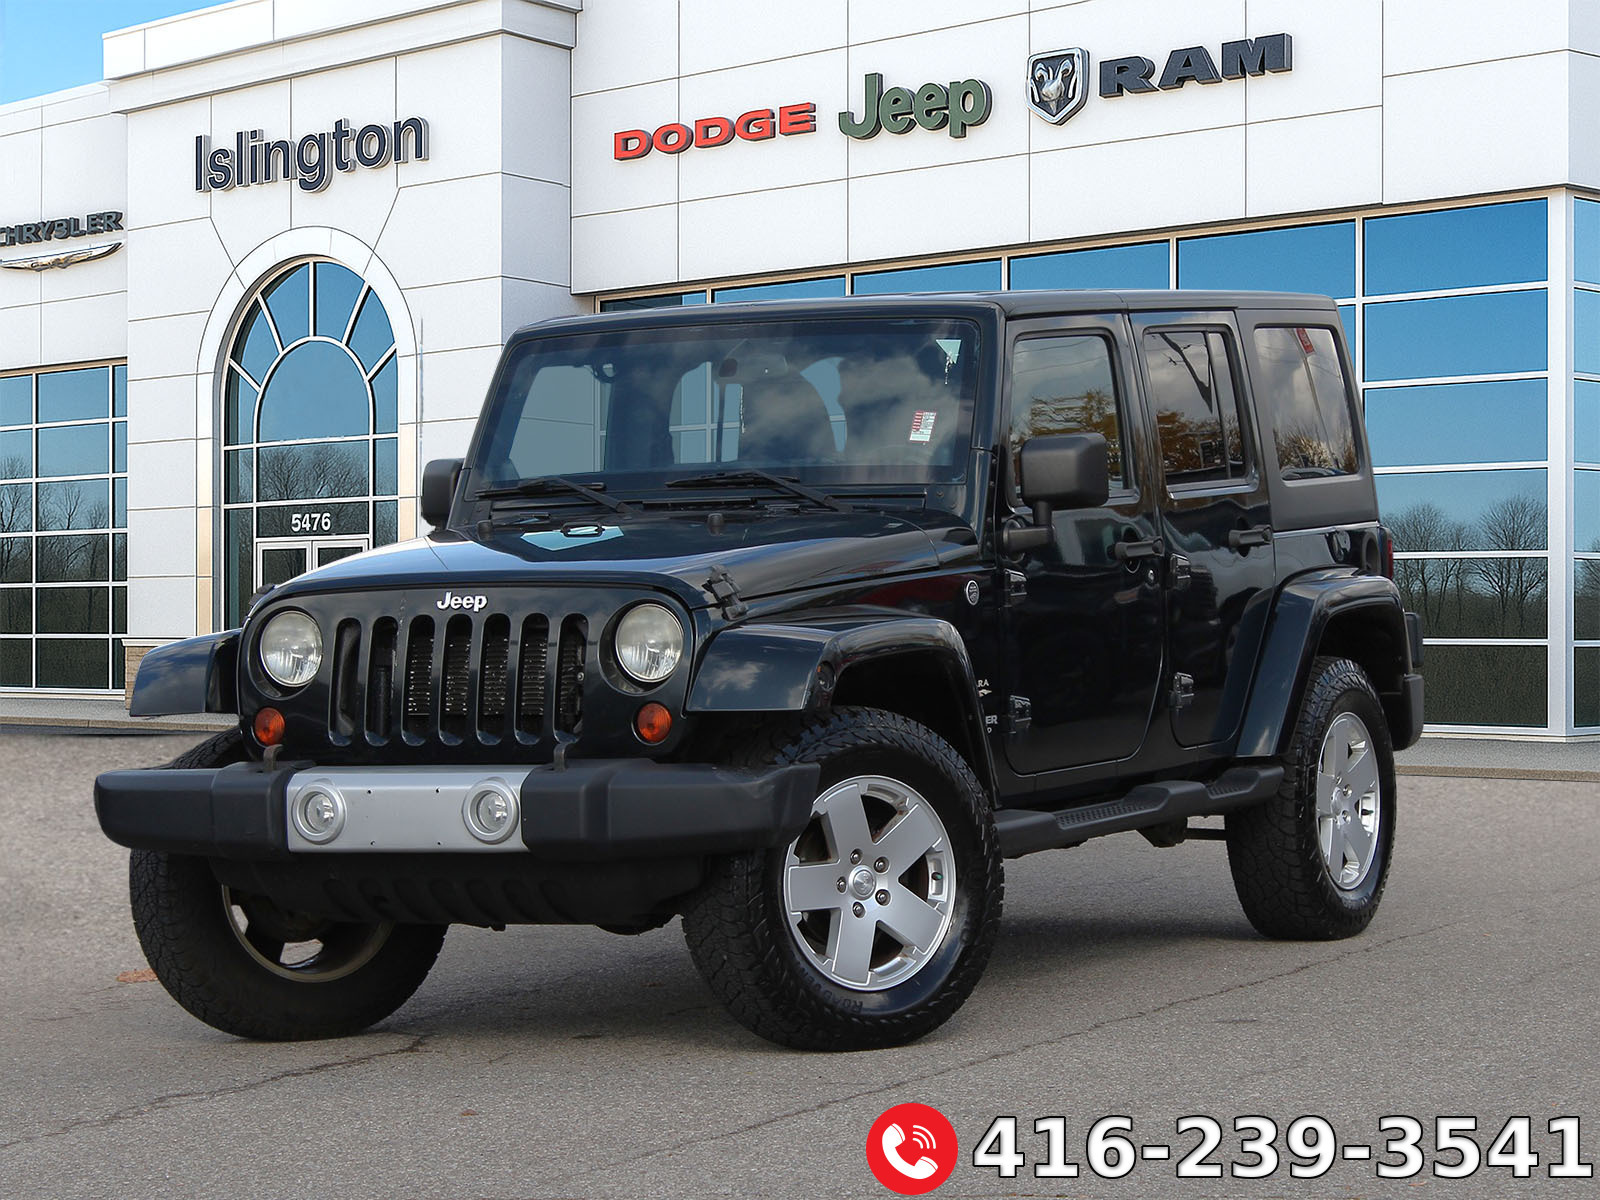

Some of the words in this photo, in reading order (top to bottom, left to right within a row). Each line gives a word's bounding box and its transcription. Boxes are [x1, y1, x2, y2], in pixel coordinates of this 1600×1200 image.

[613, 102, 817, 161] DODGE
[838, 72, 993, 140] Jeep
[1099, 33, 1293, 99] RAM
[195, 116, 430, 193] Islington
[291, 512, 331, 532] 5476
[436, 591, 488, 613] Jeep
